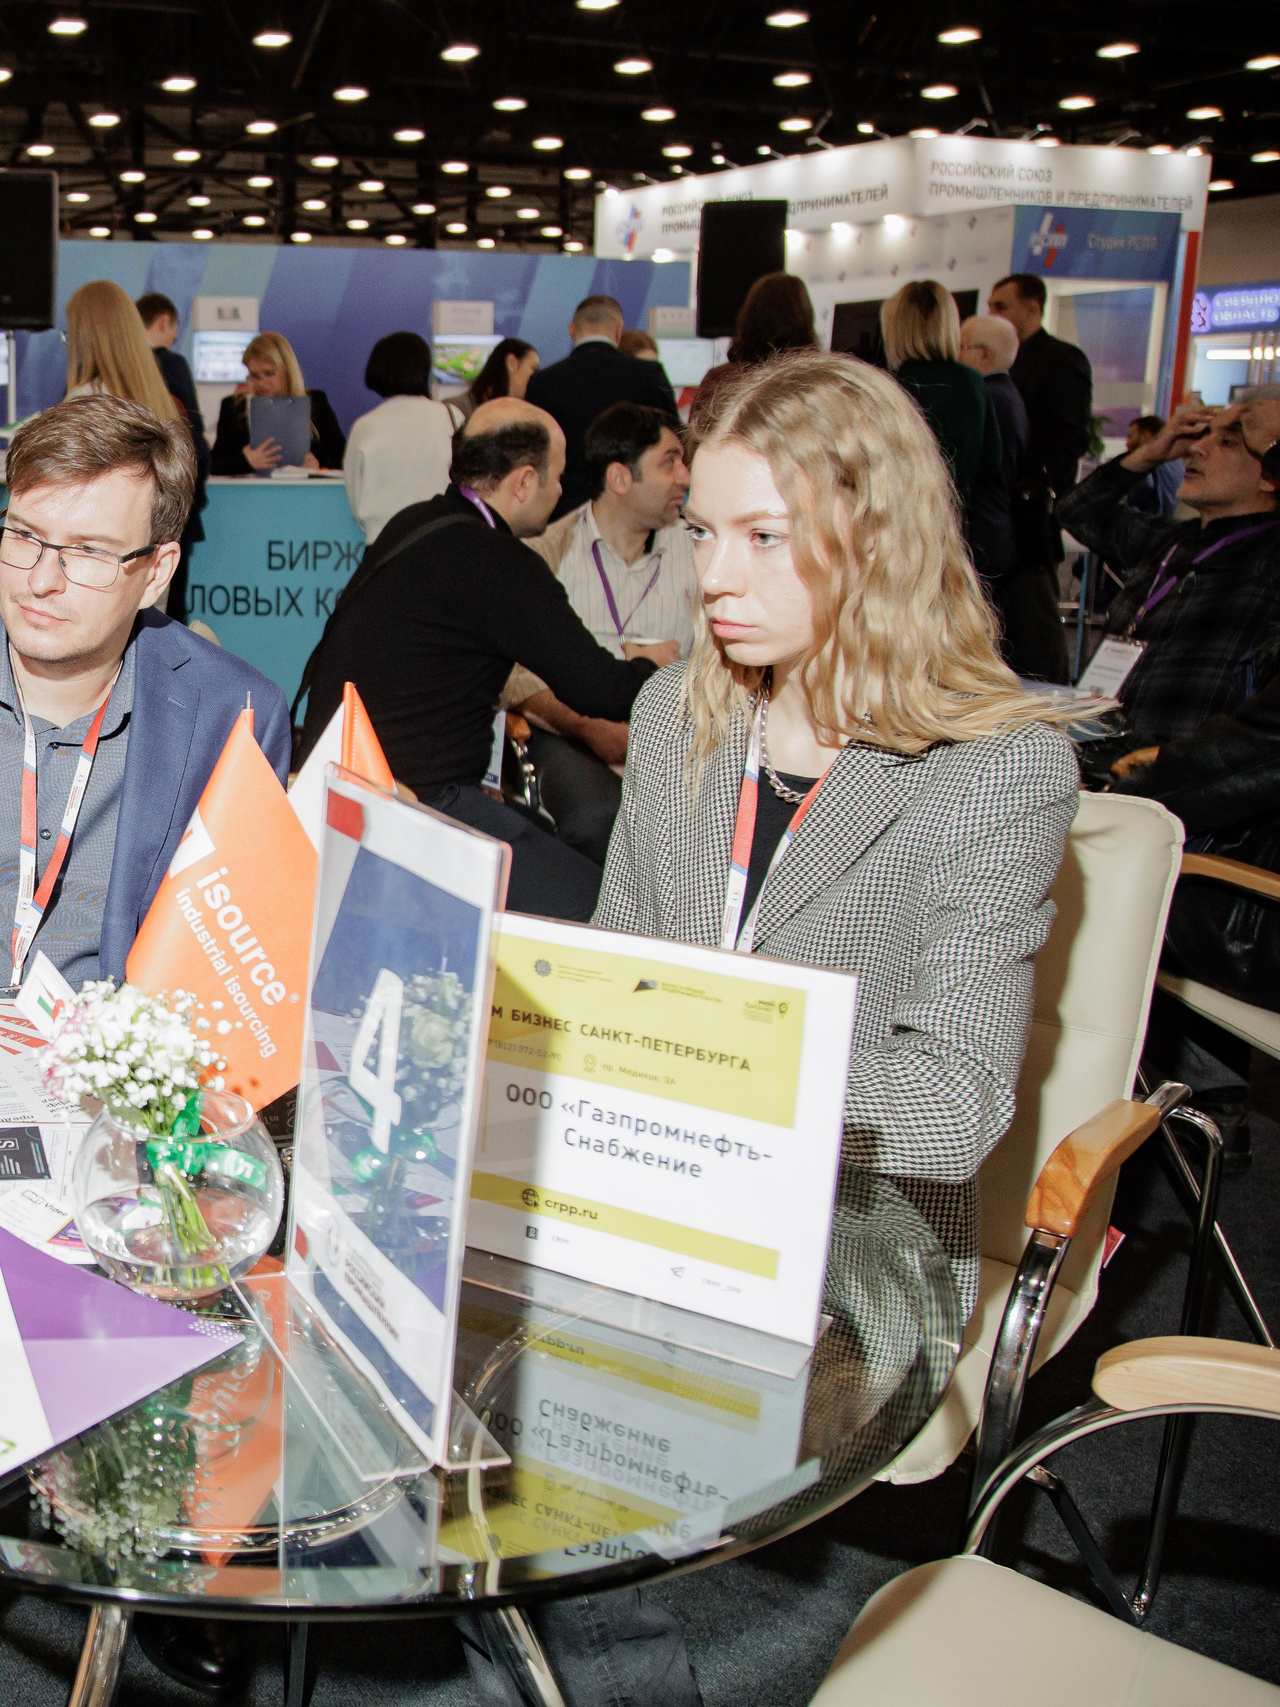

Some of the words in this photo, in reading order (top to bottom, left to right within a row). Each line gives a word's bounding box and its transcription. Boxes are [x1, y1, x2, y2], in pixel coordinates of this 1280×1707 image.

[931, 160, 1014, 180] РОССИЙСКИЙ
[1020, 167, 1053, 183] СОЮЗ
[789, 181, 889, 214] ДПРИНИМАТЕЛЕЙ
[930, 181, 1053, 205] ПРОМЫШЛЕННИКОВ
[1057, 192, 1065, 205] И
[1069, 192, 1194, 213] ПРЕДПРИНИМАТЕЛЕЙ
[268, 540, 365, 571] БИРЖ
[187, 585, 303, 617] ЛОВЫХ
[197, 866, 287, 1006] isource
[175, 888, 234, 977] industrial
[224, 974, 278, 1060] isourcing
[511, 1009, 572, 1033] БИЗНЕС
[580, 1023, 752, 1072] САНКТ-ПЕТЕРБУРГА
[349, 967, 404, 1154] 4
[602, 1063, 616, 1074] пр.
[506, 1083, 553, 1110] ООО
[561, 1099, 773, 1162] «Газпромнефть-
[563, 1128, 703, 1178] Снабжение
[545, 1198, 599, 1221] crpp.ru
